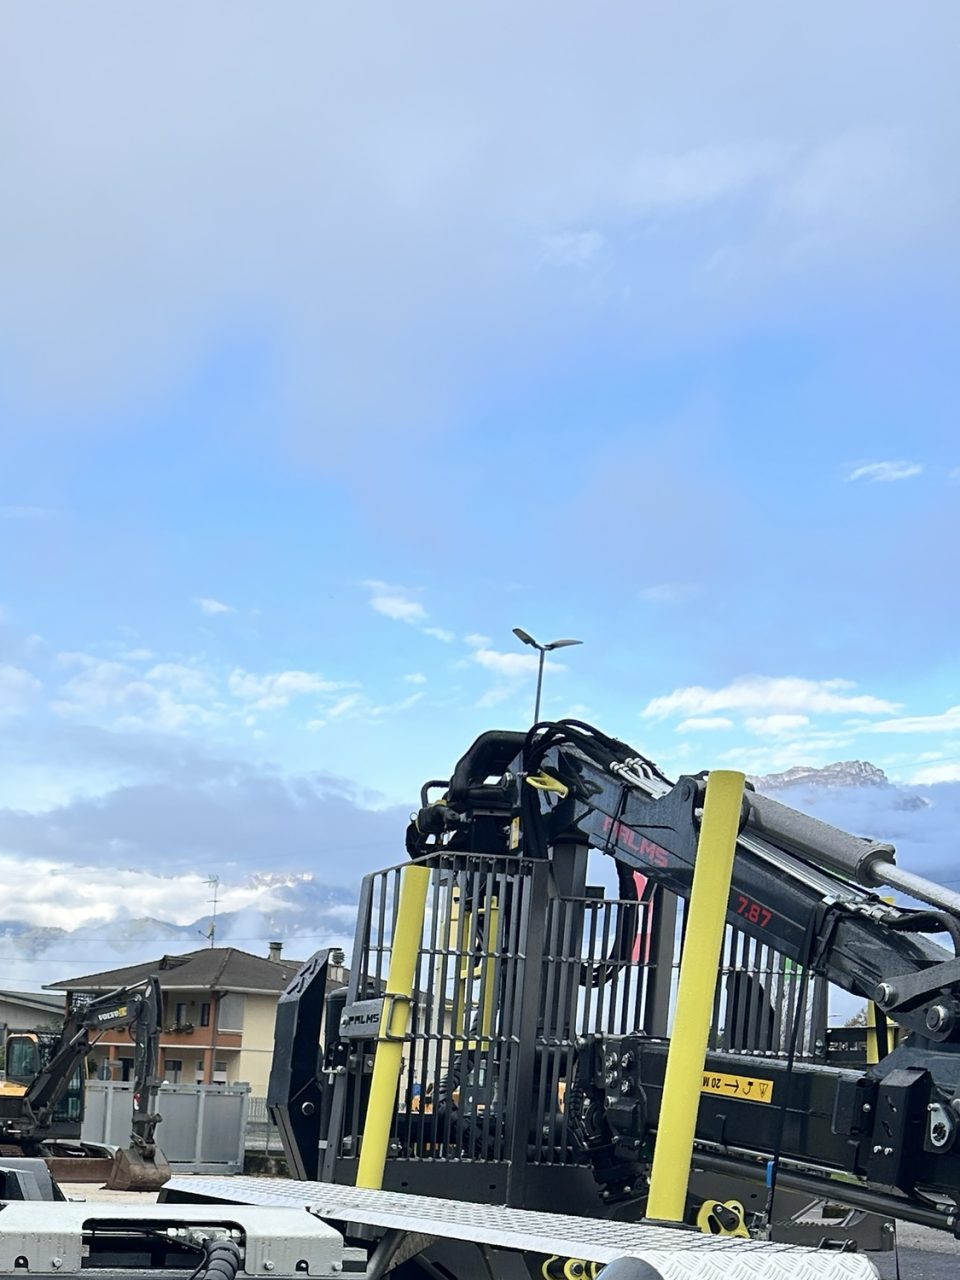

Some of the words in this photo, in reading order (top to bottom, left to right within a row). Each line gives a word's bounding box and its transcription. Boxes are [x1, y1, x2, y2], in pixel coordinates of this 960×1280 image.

[737, 895, 773, 927] 7.87
[98, 1010, 119, 1021] VOLVO
[349, 1014, 380, 1025] PALMS
[711, 1077, 721, 1089] 20
